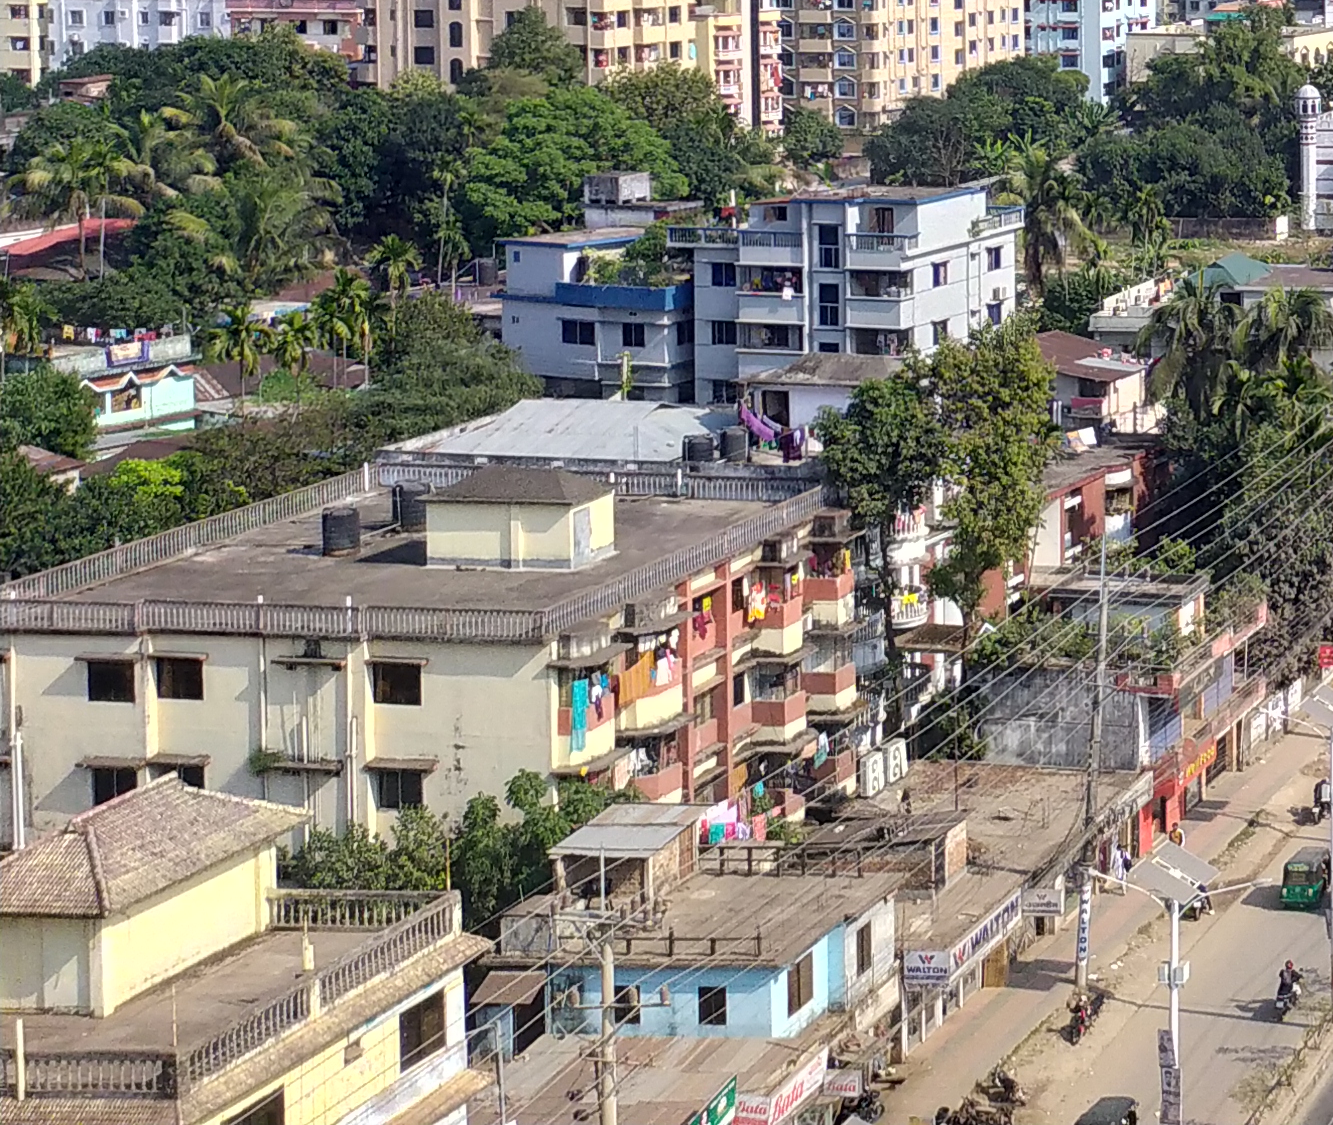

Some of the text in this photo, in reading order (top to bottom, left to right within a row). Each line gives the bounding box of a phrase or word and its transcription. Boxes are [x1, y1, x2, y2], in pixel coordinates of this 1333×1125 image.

[970, 895, 1020, 951] WALTON
[1079, 898, 1090, 954] WALTON
[906, 965, 948, 975] WALTON
[826, 1080, 856, 1093] Bata
[738, 1100, 767, 1115] Bata
[769, 1079, 805, 1125] Bata
